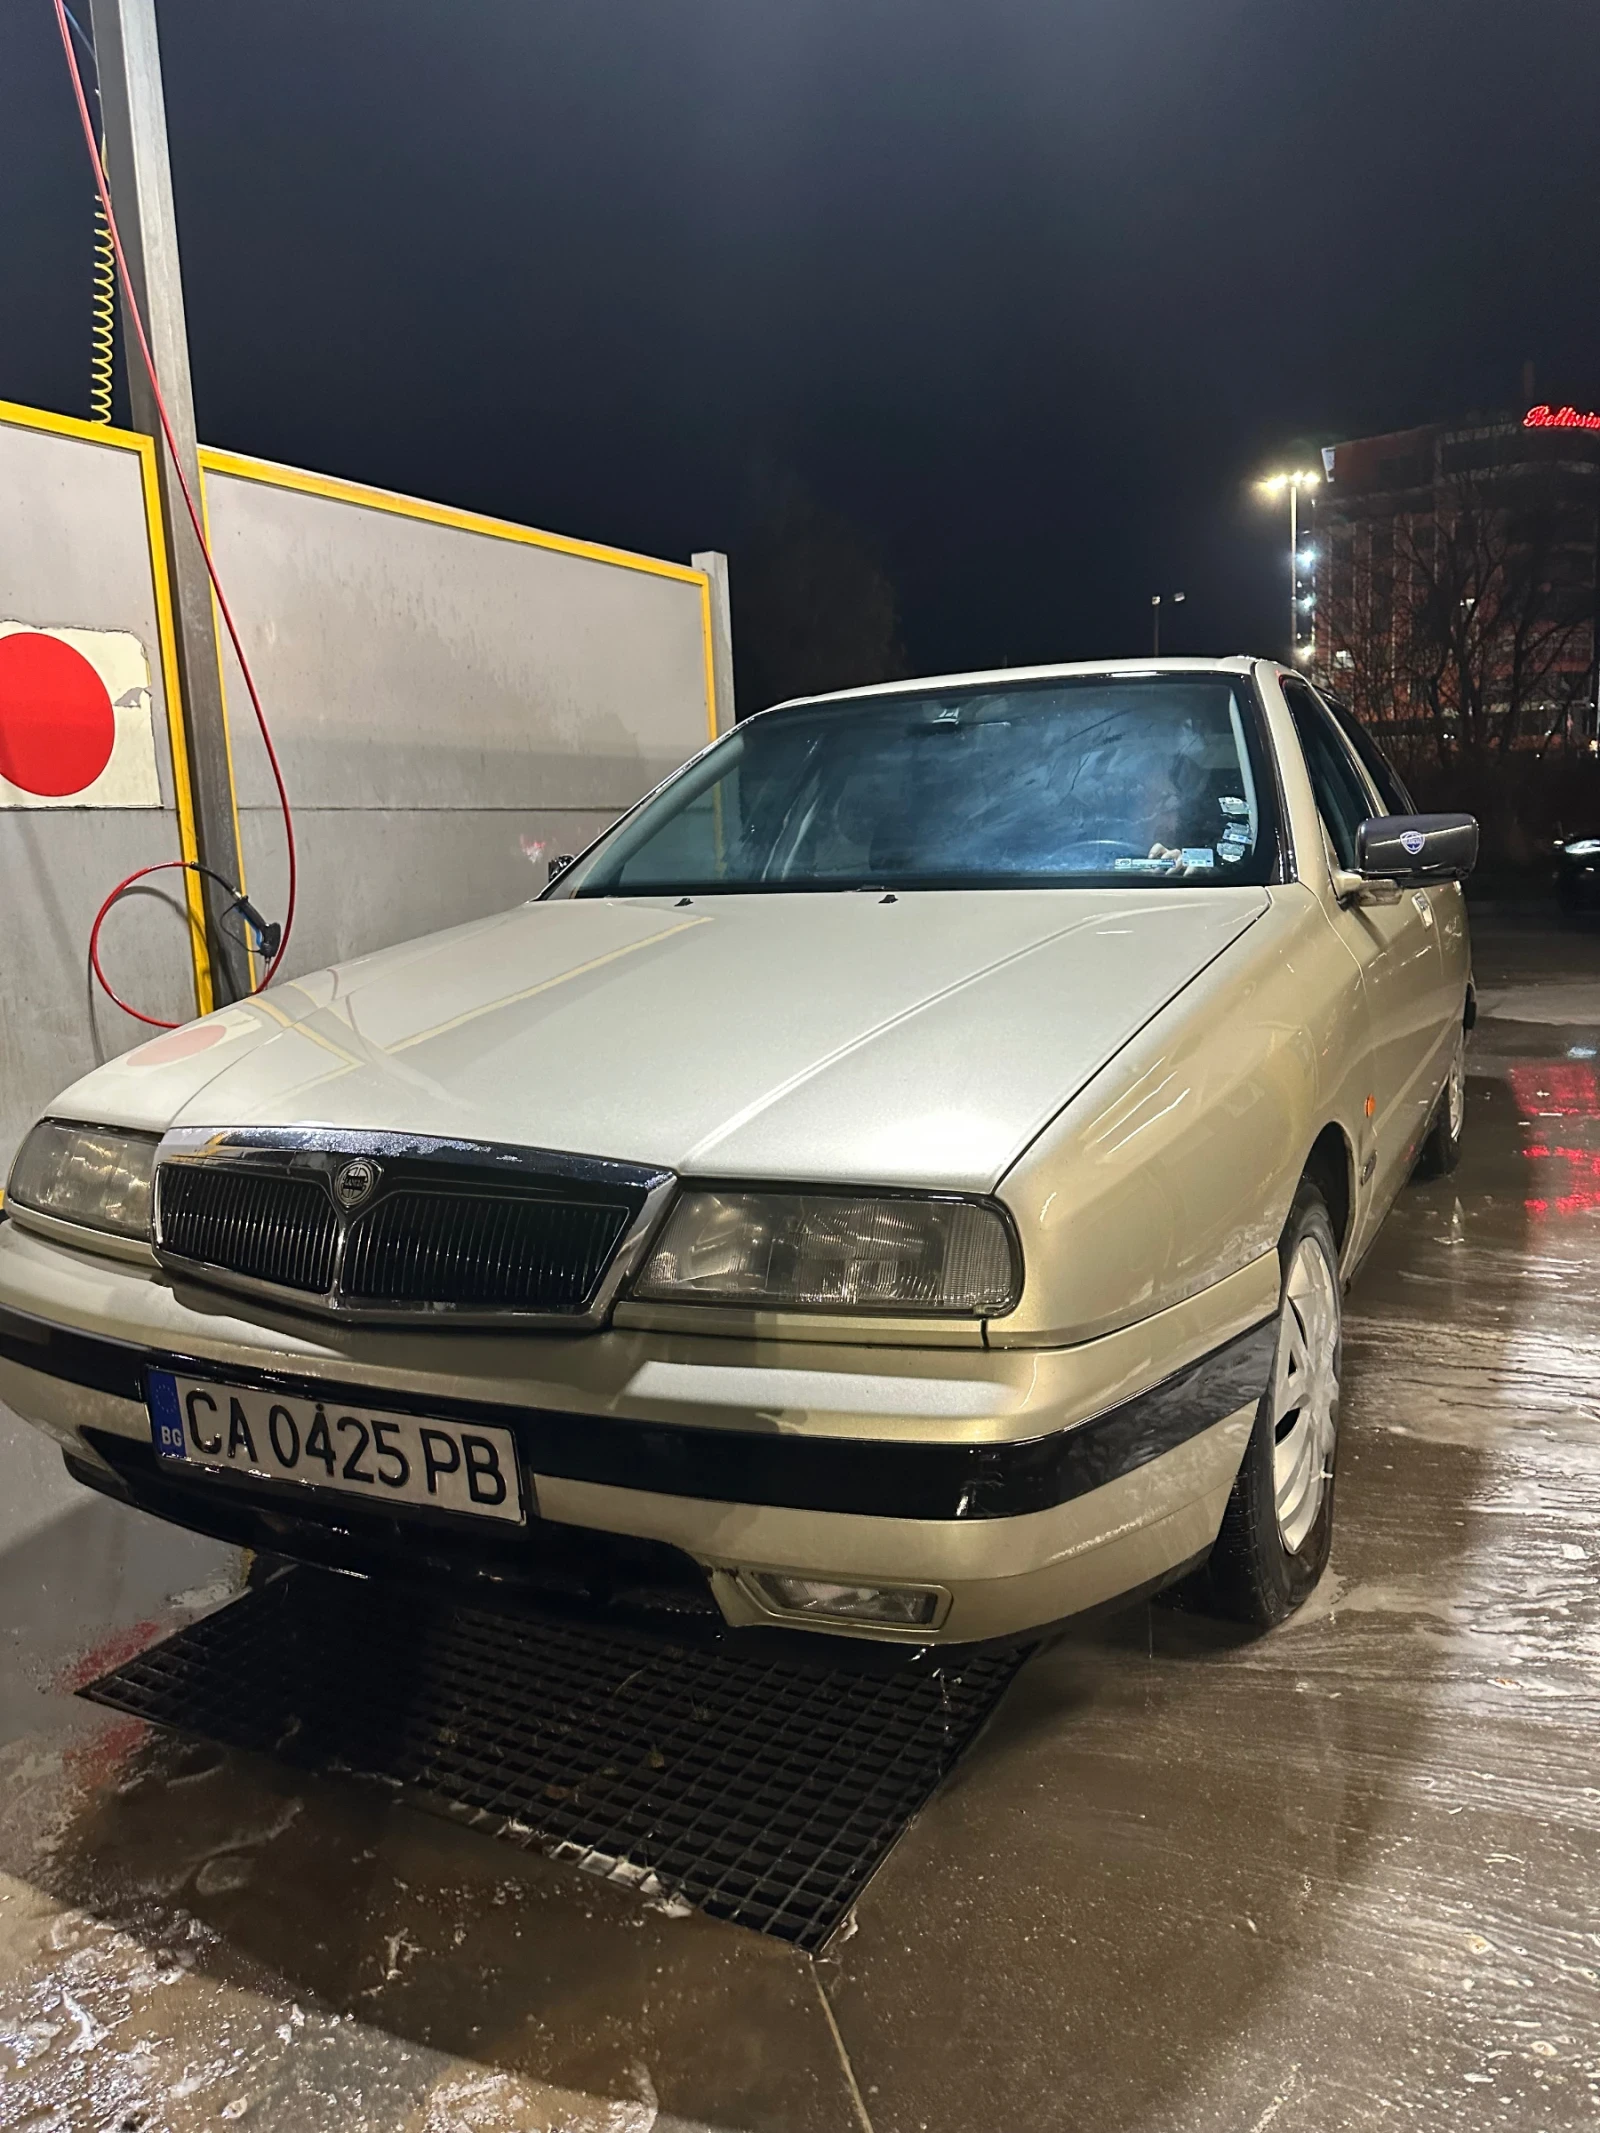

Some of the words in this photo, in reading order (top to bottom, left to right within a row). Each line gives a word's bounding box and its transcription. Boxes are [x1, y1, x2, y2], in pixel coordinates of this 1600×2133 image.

[161, 1426, 182, 1447] BG
[186, 1390, 258, 1462] CA
[269, 1404, 410, 1487] 0425
[419, 1428, 506, 1505] PB
